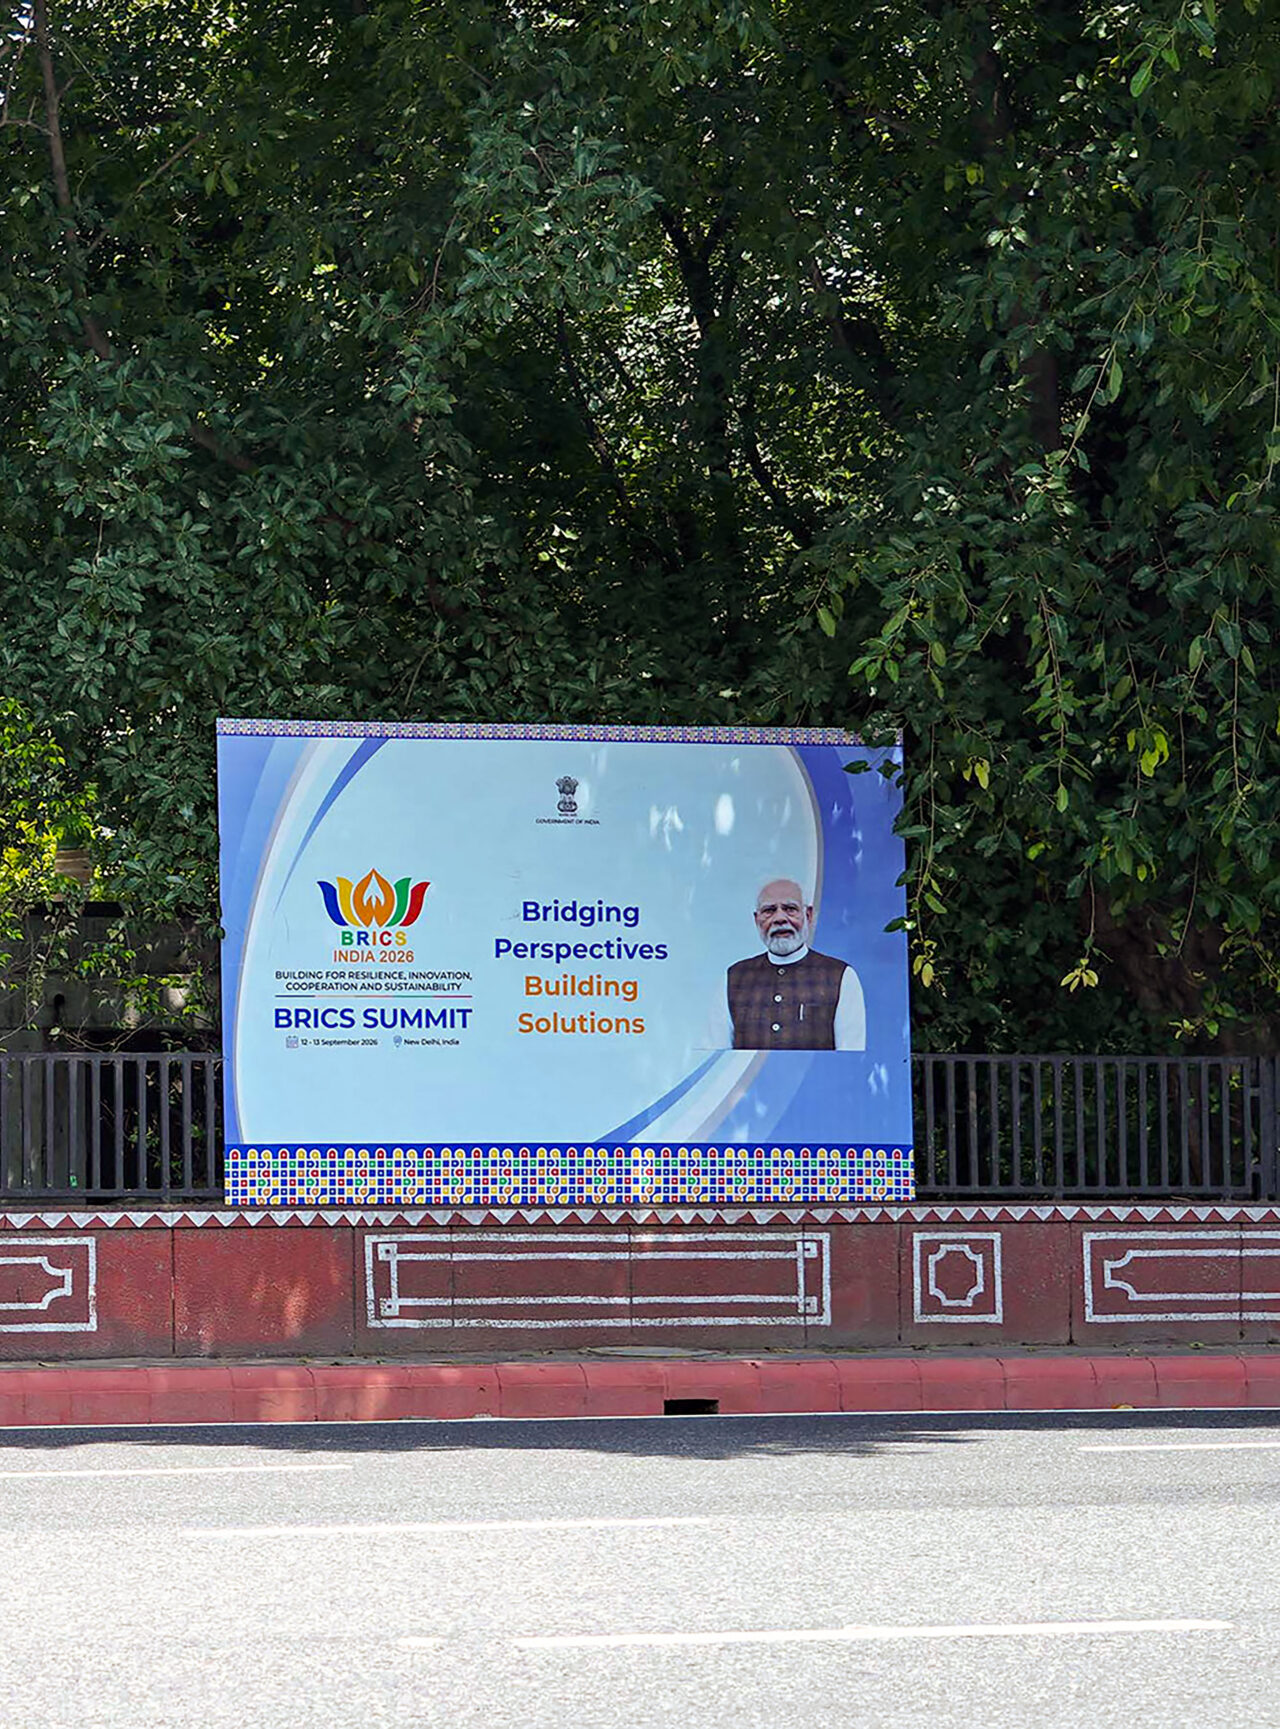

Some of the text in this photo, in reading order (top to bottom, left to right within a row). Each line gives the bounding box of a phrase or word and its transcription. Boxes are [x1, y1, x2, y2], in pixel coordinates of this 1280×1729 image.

[522, 899, 639, 928] Bridging
[341, 930, 407, 946] BRICS
[333, 949, 415, 963] INDIA 2026
[495, 937, 668, 964] Perspectives
[275, 970, 473, 981] BUILDING FOR RESILIENCE, INNOVATION,
[285, 982, 462, 991] COOPERATION AND SUSTAINABILITY
[525, 974, 638, 1002] Building
[274, 1008, 473, 1029] BRICS SUMMIT
[518, 1011, 645, 1034] Solutions
[321, 1038, 360, 1048] September
[404, 1038, 420, 1046] New
[442, 1038, 460, 1046] India
